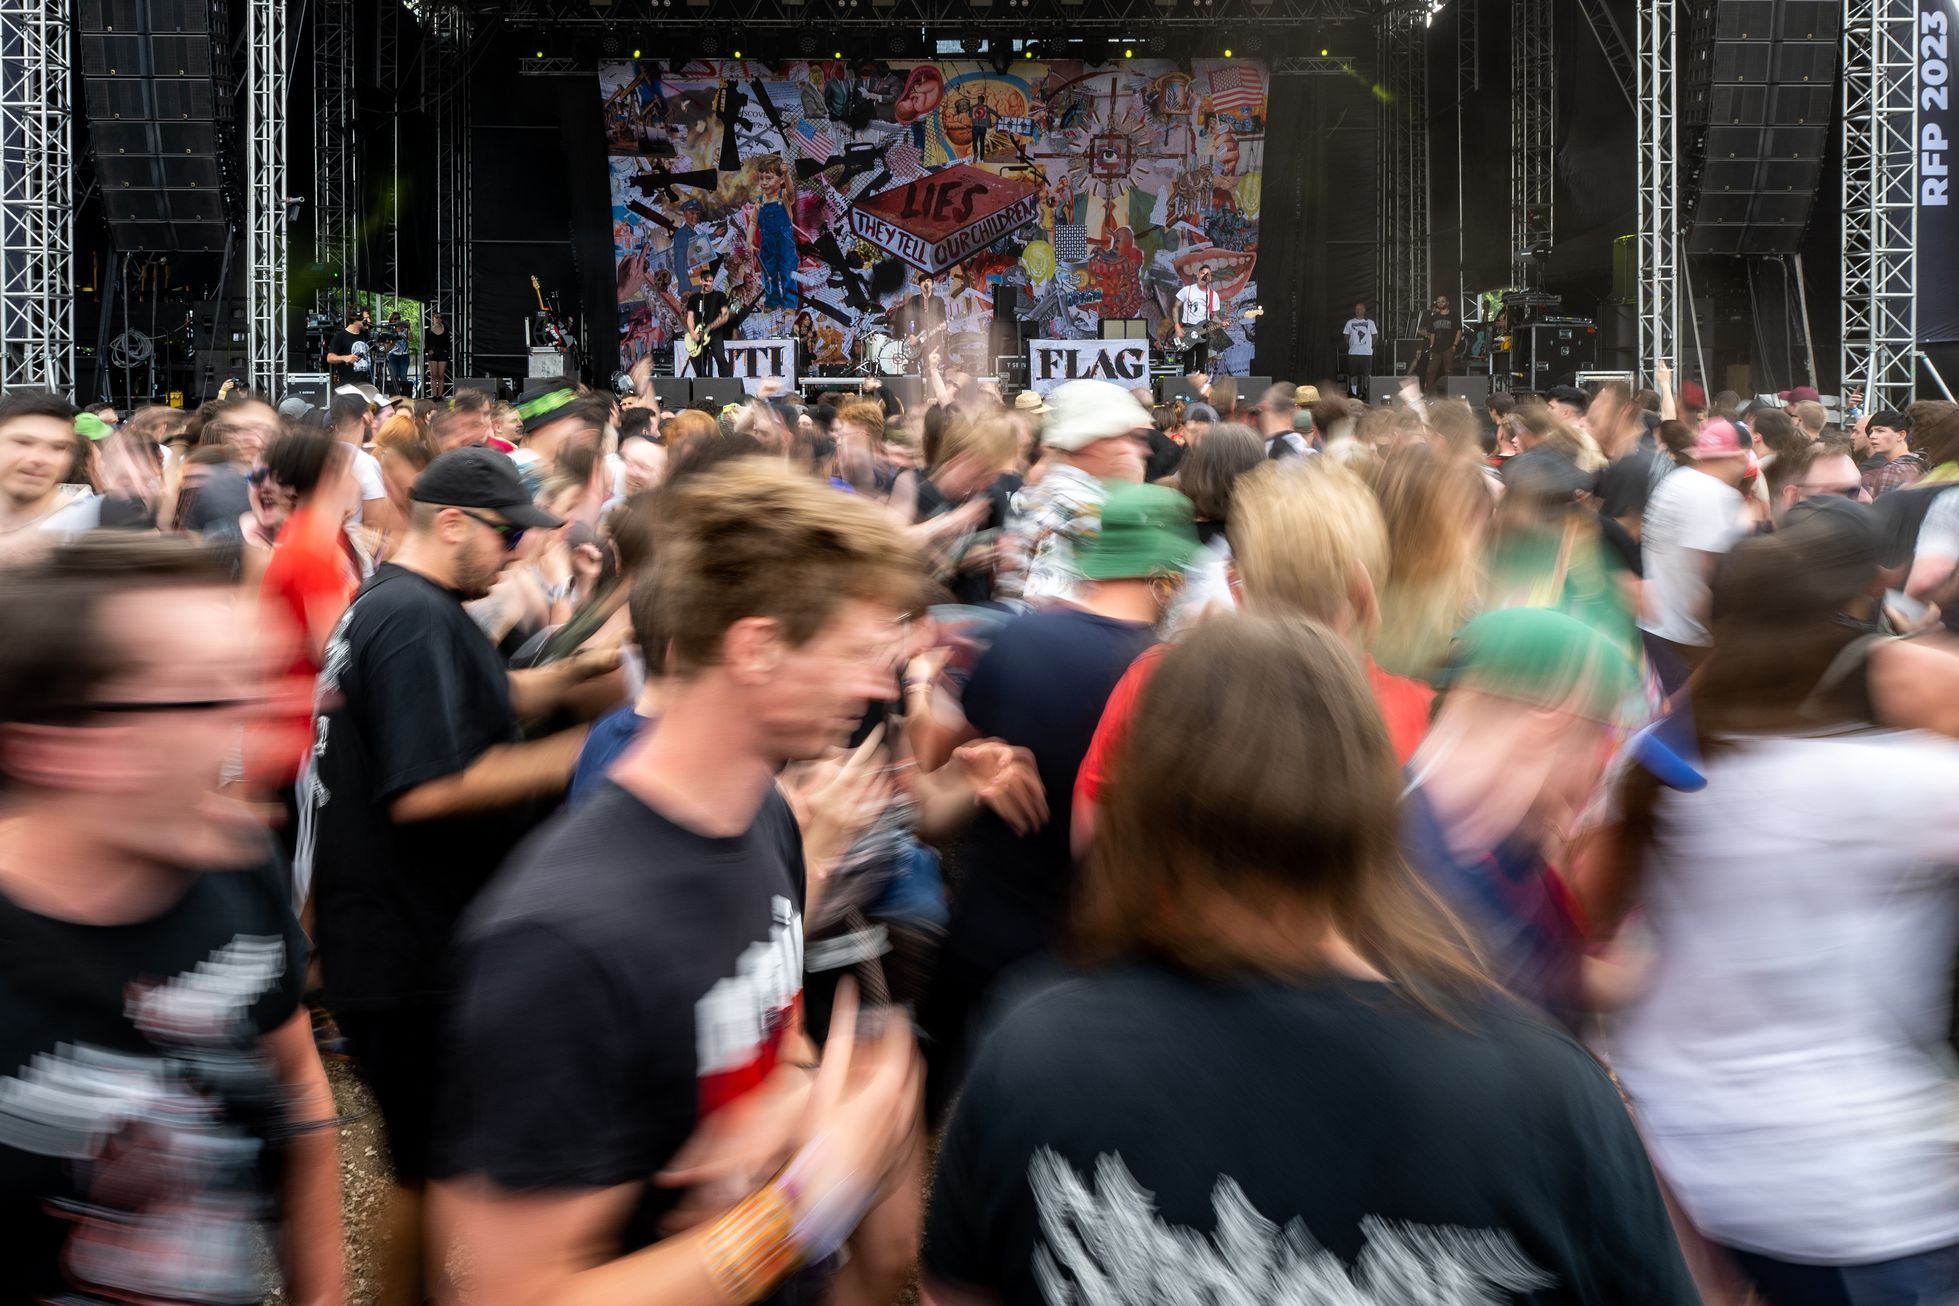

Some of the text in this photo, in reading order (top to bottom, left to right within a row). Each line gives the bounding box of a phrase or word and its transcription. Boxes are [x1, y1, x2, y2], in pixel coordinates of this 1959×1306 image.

[1920, 10, 1948, 206] RFP 2023
[900, 181, 989, 223] LIES
[855, 196, 1033, 266] THEY TELL OUR CHILDREN
[1036, 348, 1146, 380] FLAG
